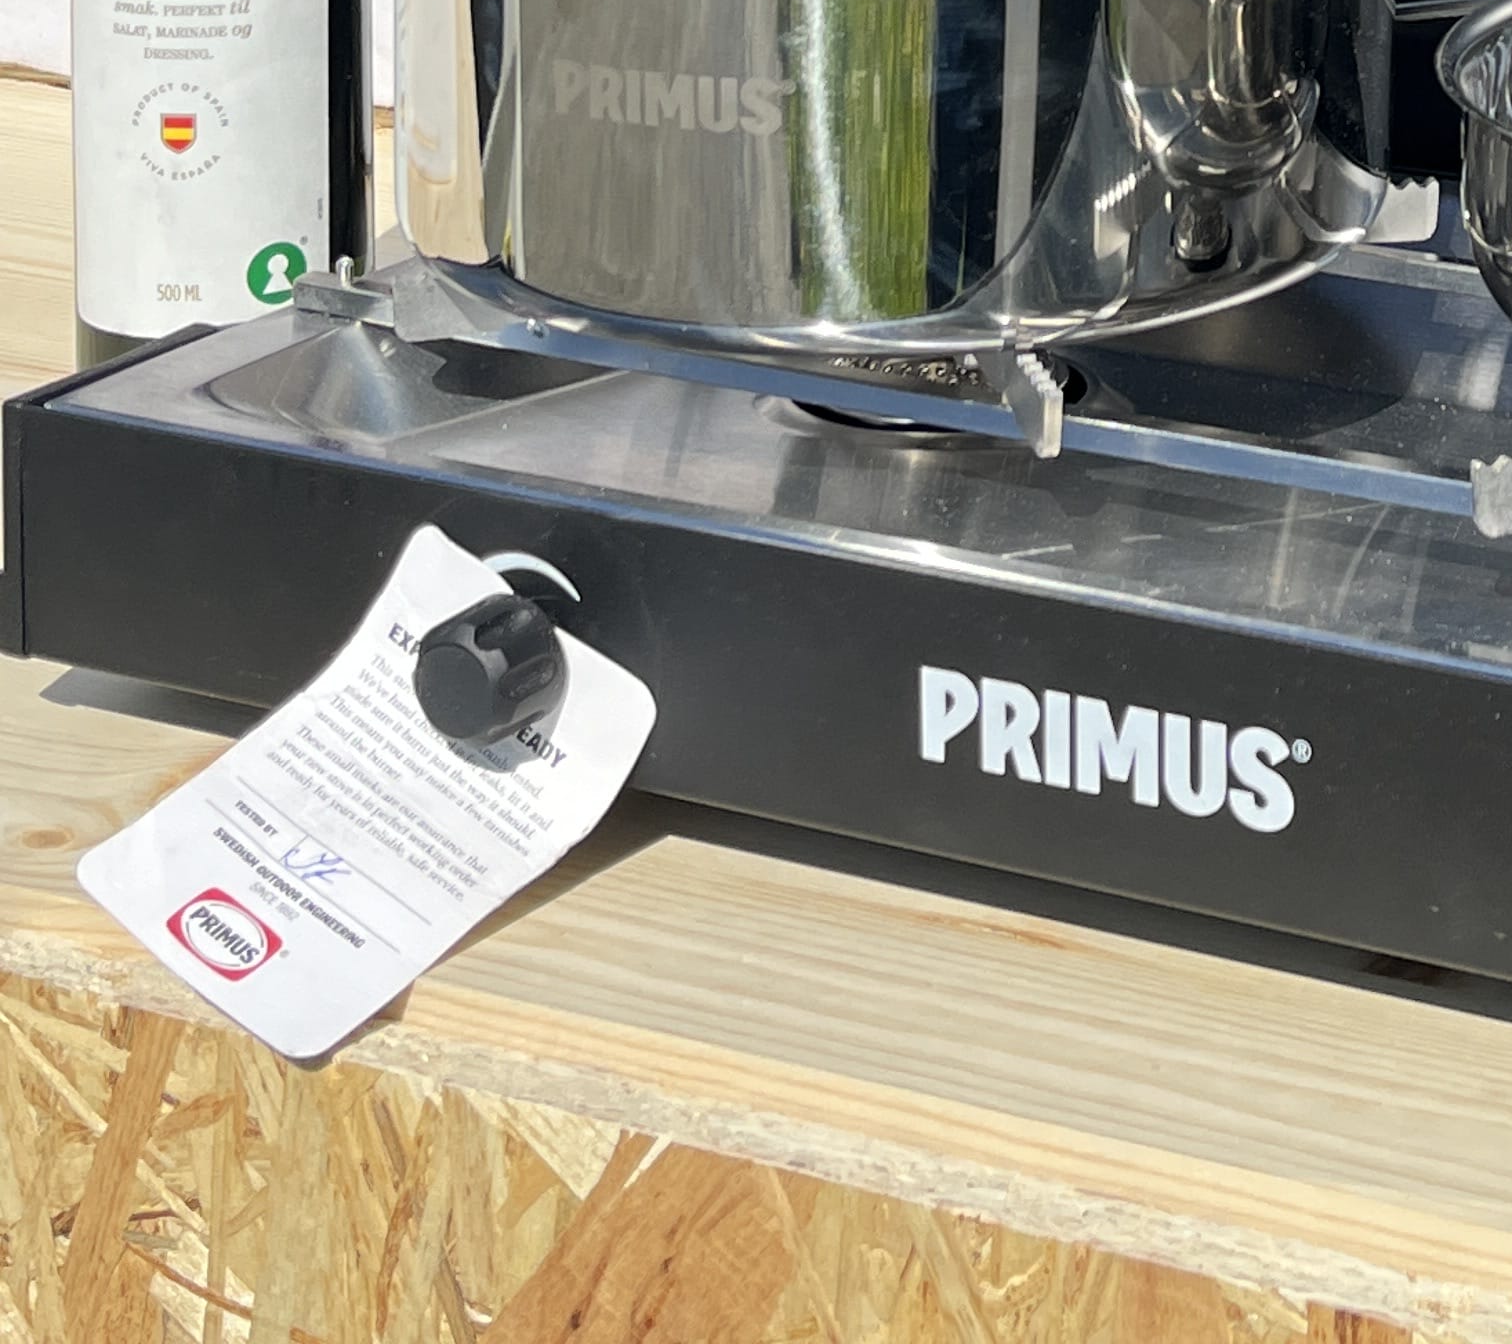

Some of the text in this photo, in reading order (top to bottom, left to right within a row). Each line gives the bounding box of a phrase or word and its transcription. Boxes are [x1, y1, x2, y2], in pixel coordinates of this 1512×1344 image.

[229, 0, 251, 15] til
[232, 24, 253, 39] og
[157, 283, 203, 302] 500 ML
[190, 905, 260, 966] PRIMUS
